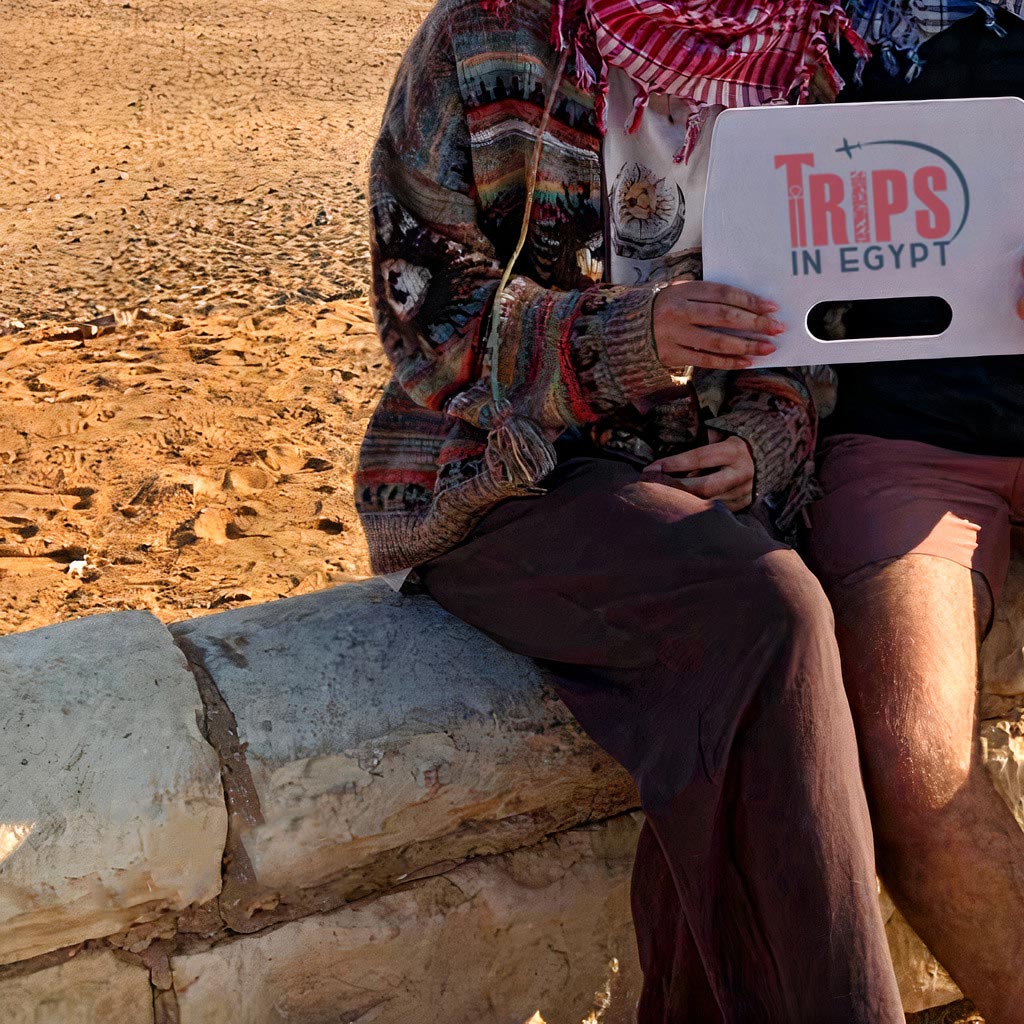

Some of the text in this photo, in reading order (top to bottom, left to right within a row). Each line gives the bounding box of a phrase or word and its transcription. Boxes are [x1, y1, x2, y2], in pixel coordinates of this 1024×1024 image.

[774, 152, 951, 248] TRIPS
[791, 240, 952, 276] IN EGYPT
